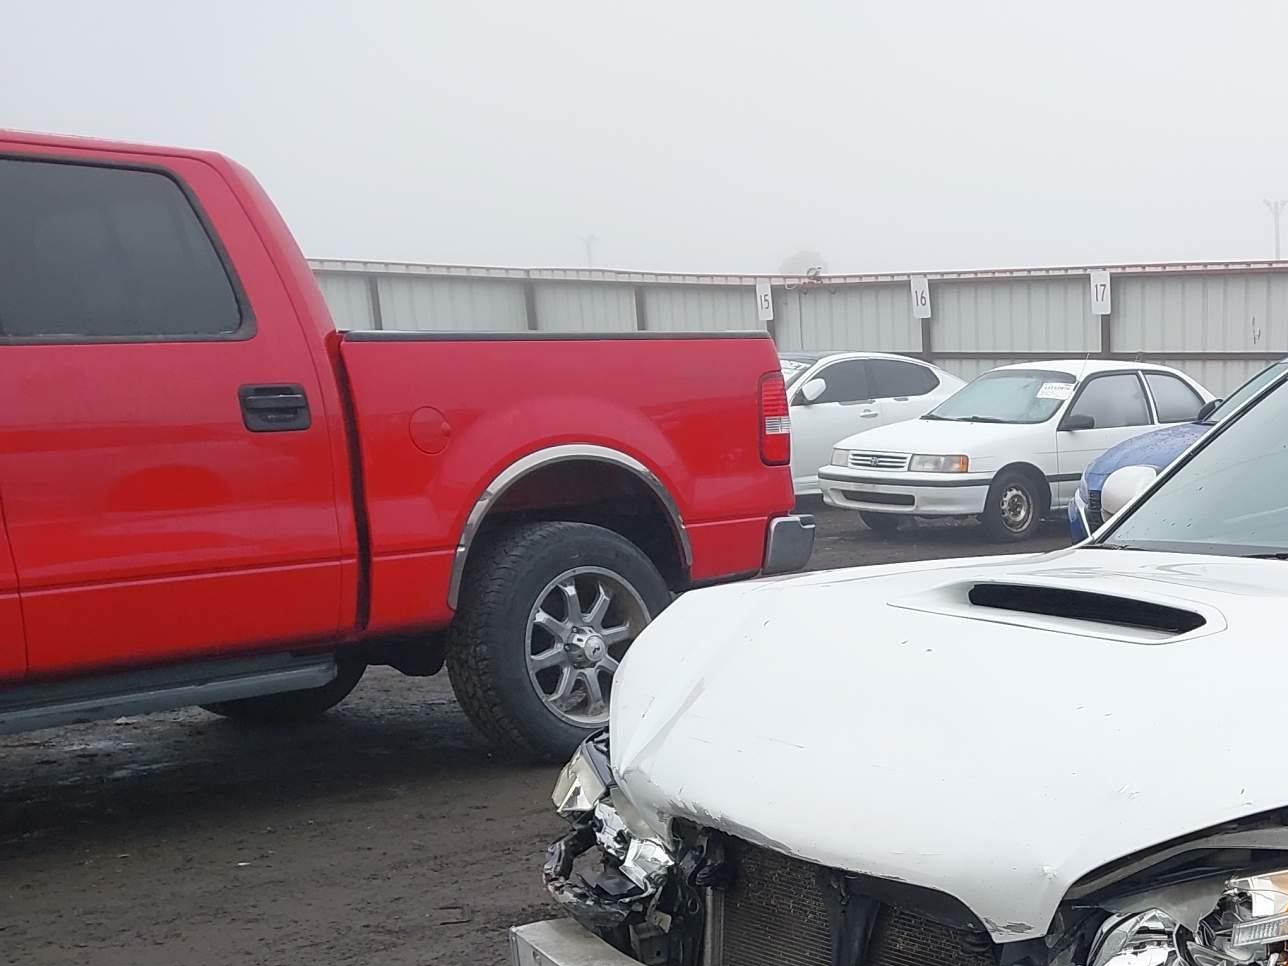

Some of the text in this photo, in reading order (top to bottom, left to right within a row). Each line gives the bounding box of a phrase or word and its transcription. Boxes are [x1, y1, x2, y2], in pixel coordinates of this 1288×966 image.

[915, 289, 927, 306] 16
[1095, 283, 1107, 302] 17
[759, 294, 770, 310] 15
